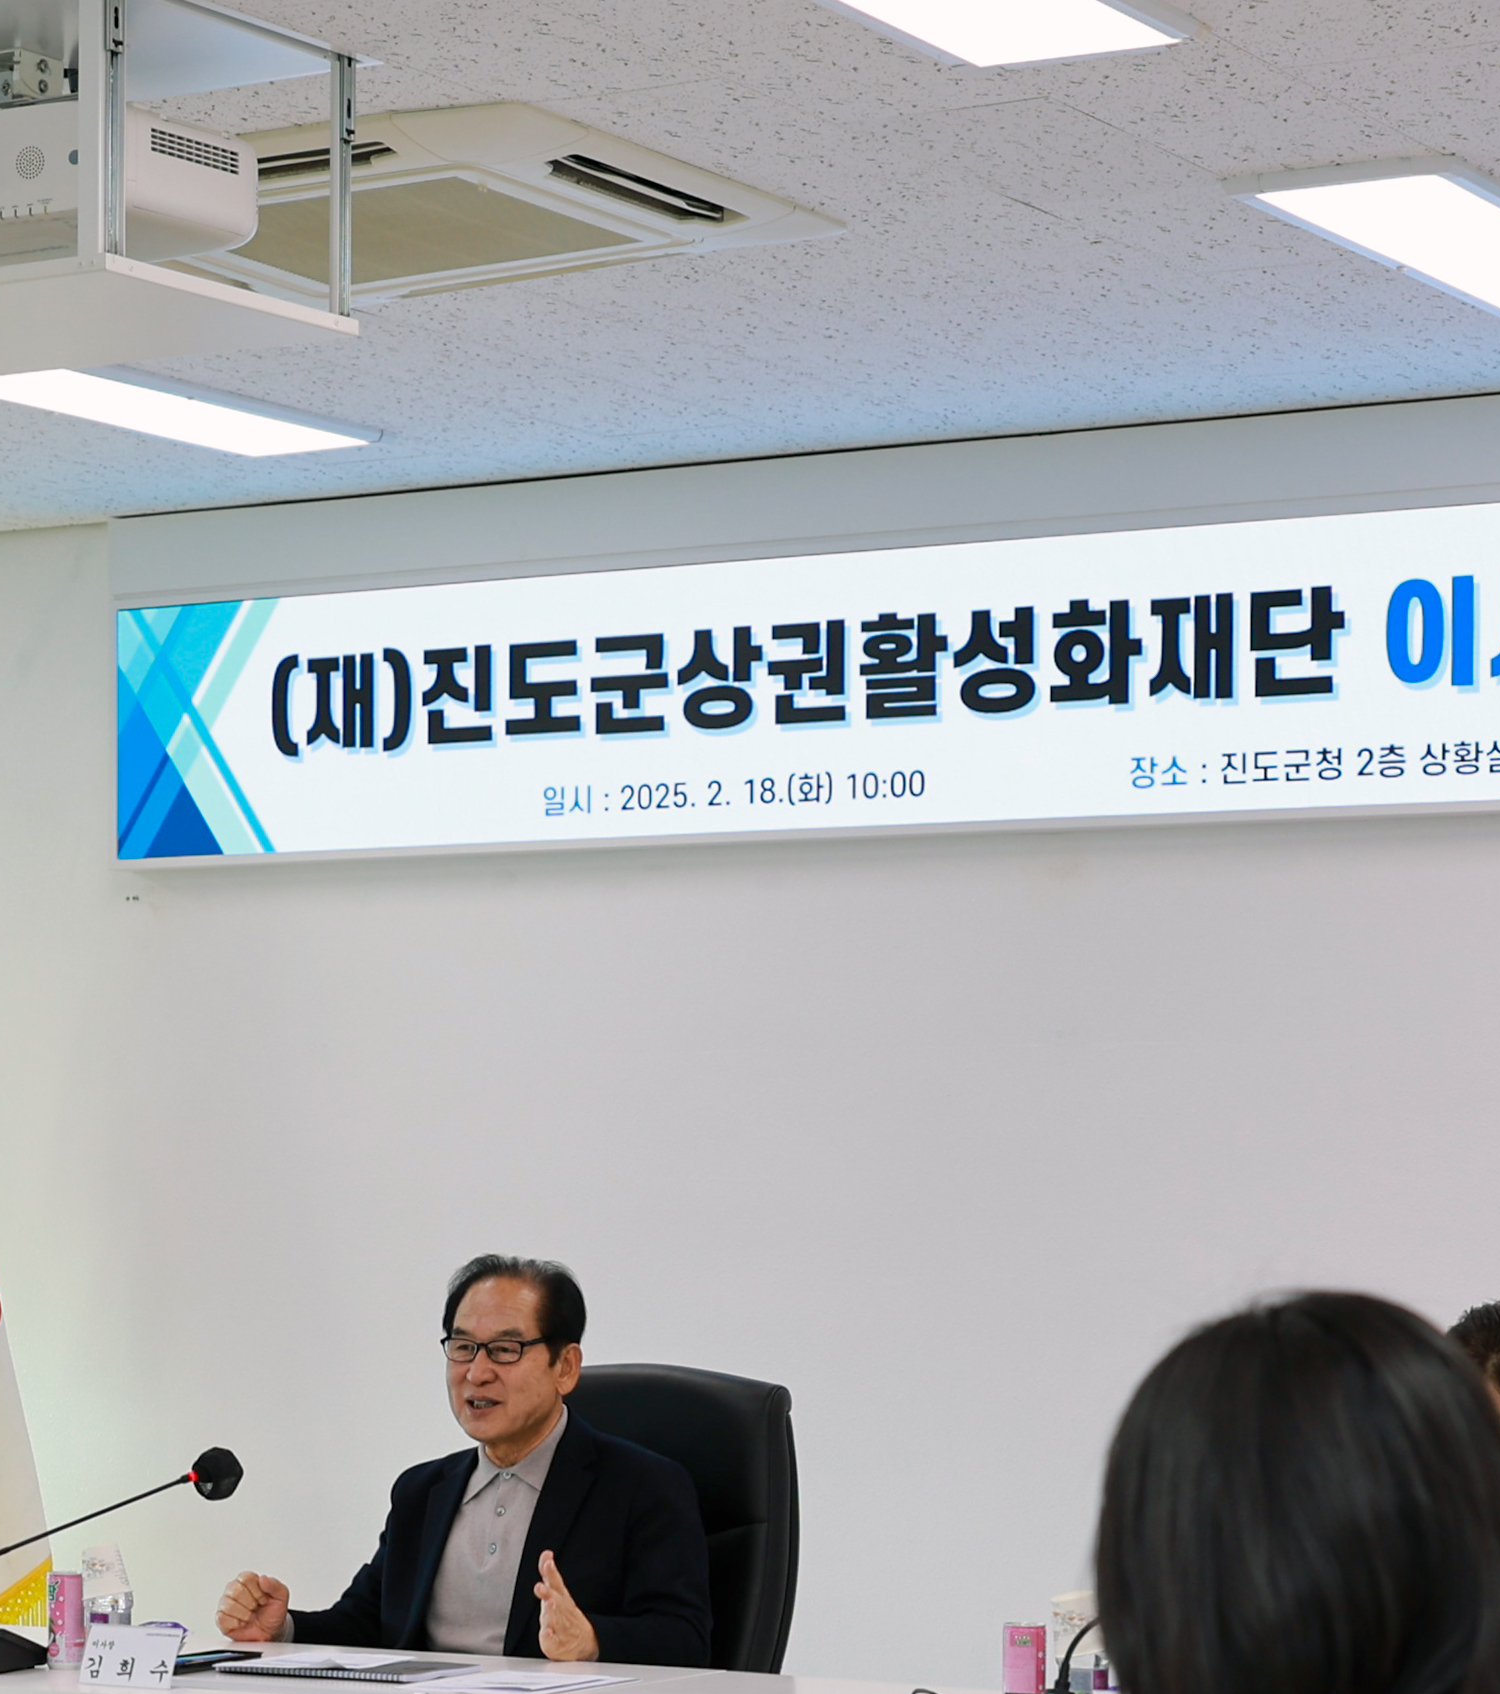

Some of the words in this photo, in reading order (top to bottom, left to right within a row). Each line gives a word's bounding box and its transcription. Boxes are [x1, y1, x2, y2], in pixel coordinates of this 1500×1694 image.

[271, 585, 1345, 757] (재)진도군상권활성화재단
[1130, 755, 1188, 789] 장소
[1220, 747, 1343, 787] 진도군청
[1357, 744, 1406, 778] 2층
[543, 784, 592, 817] 일시
[620, 782, 696, 811] 2025.
[707, 779, 731, 806] 2.
[744, 771, 833, 806] 18.(화)
[847, 770, 926, 799] 10:00
